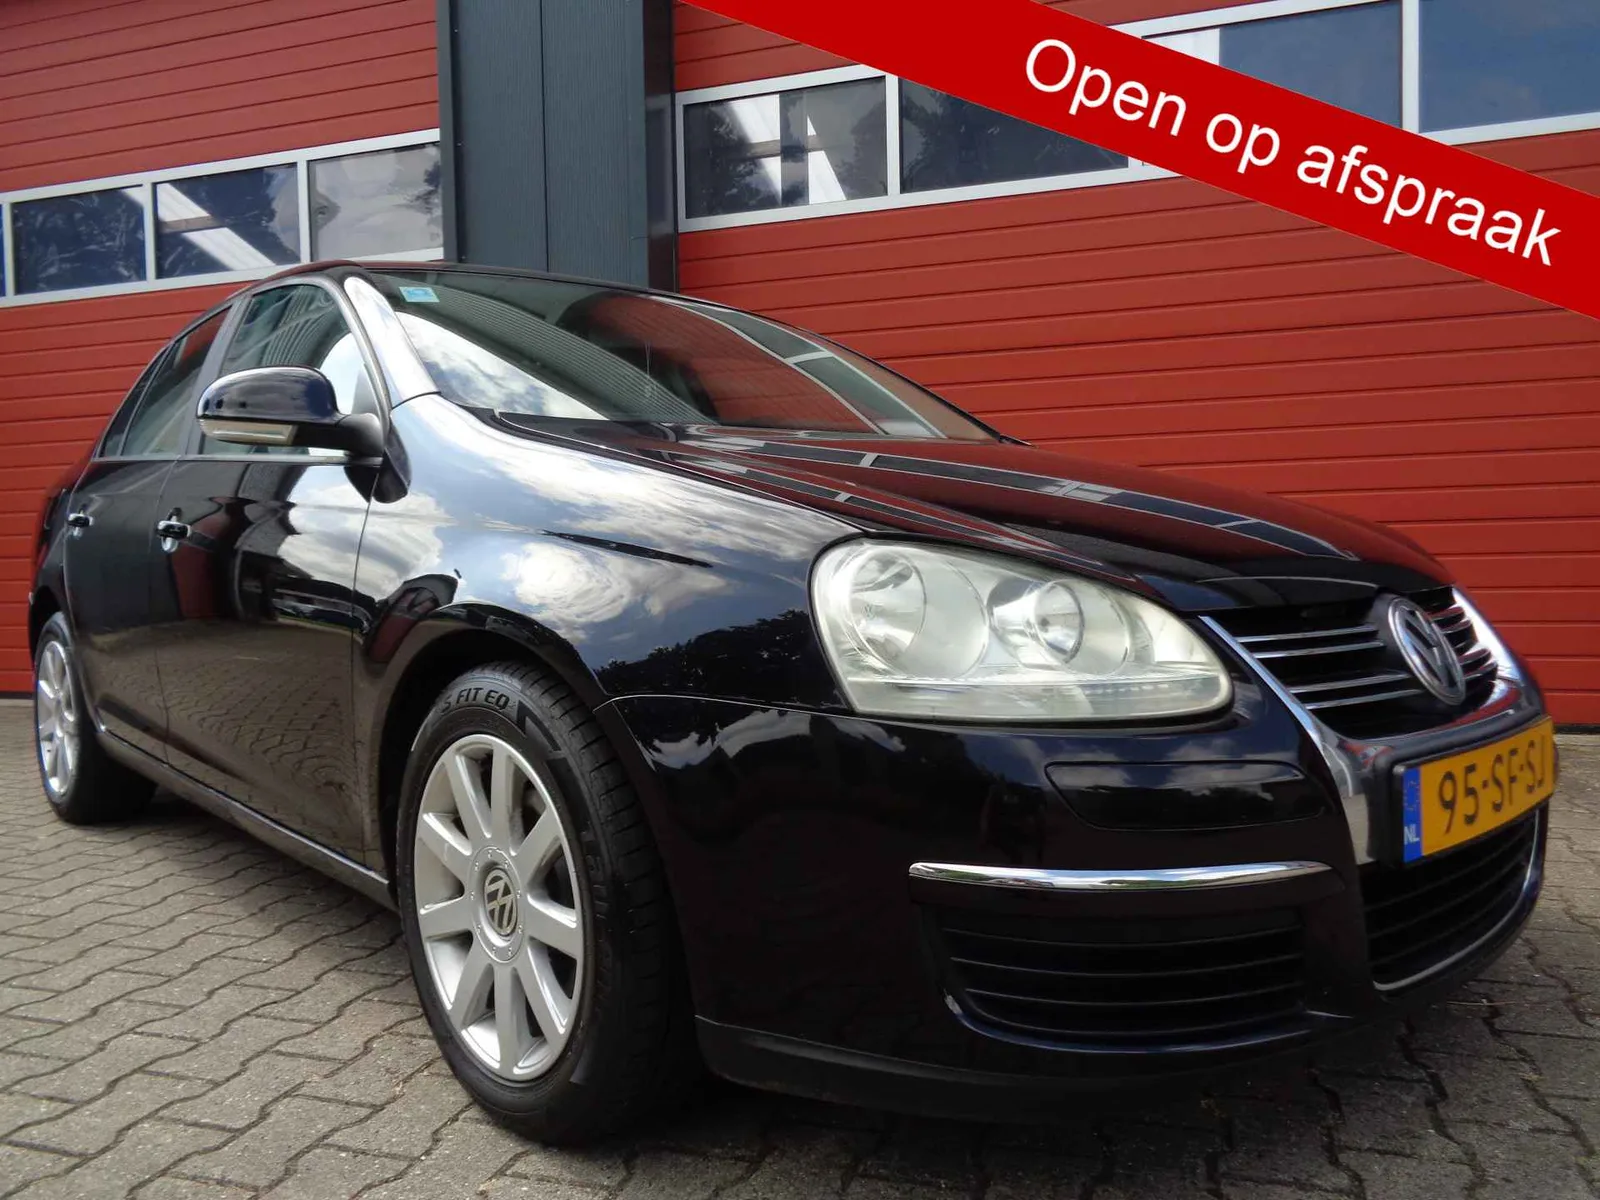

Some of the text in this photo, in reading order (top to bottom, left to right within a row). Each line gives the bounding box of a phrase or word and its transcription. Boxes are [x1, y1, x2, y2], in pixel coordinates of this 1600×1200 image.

[456, 687, 484, 705] FIT
[484, 689, 510, 711] EQ
[1438, 734, 1545, 836] 95-SF-SJ
[1403, 823, 1421, 846] NL
